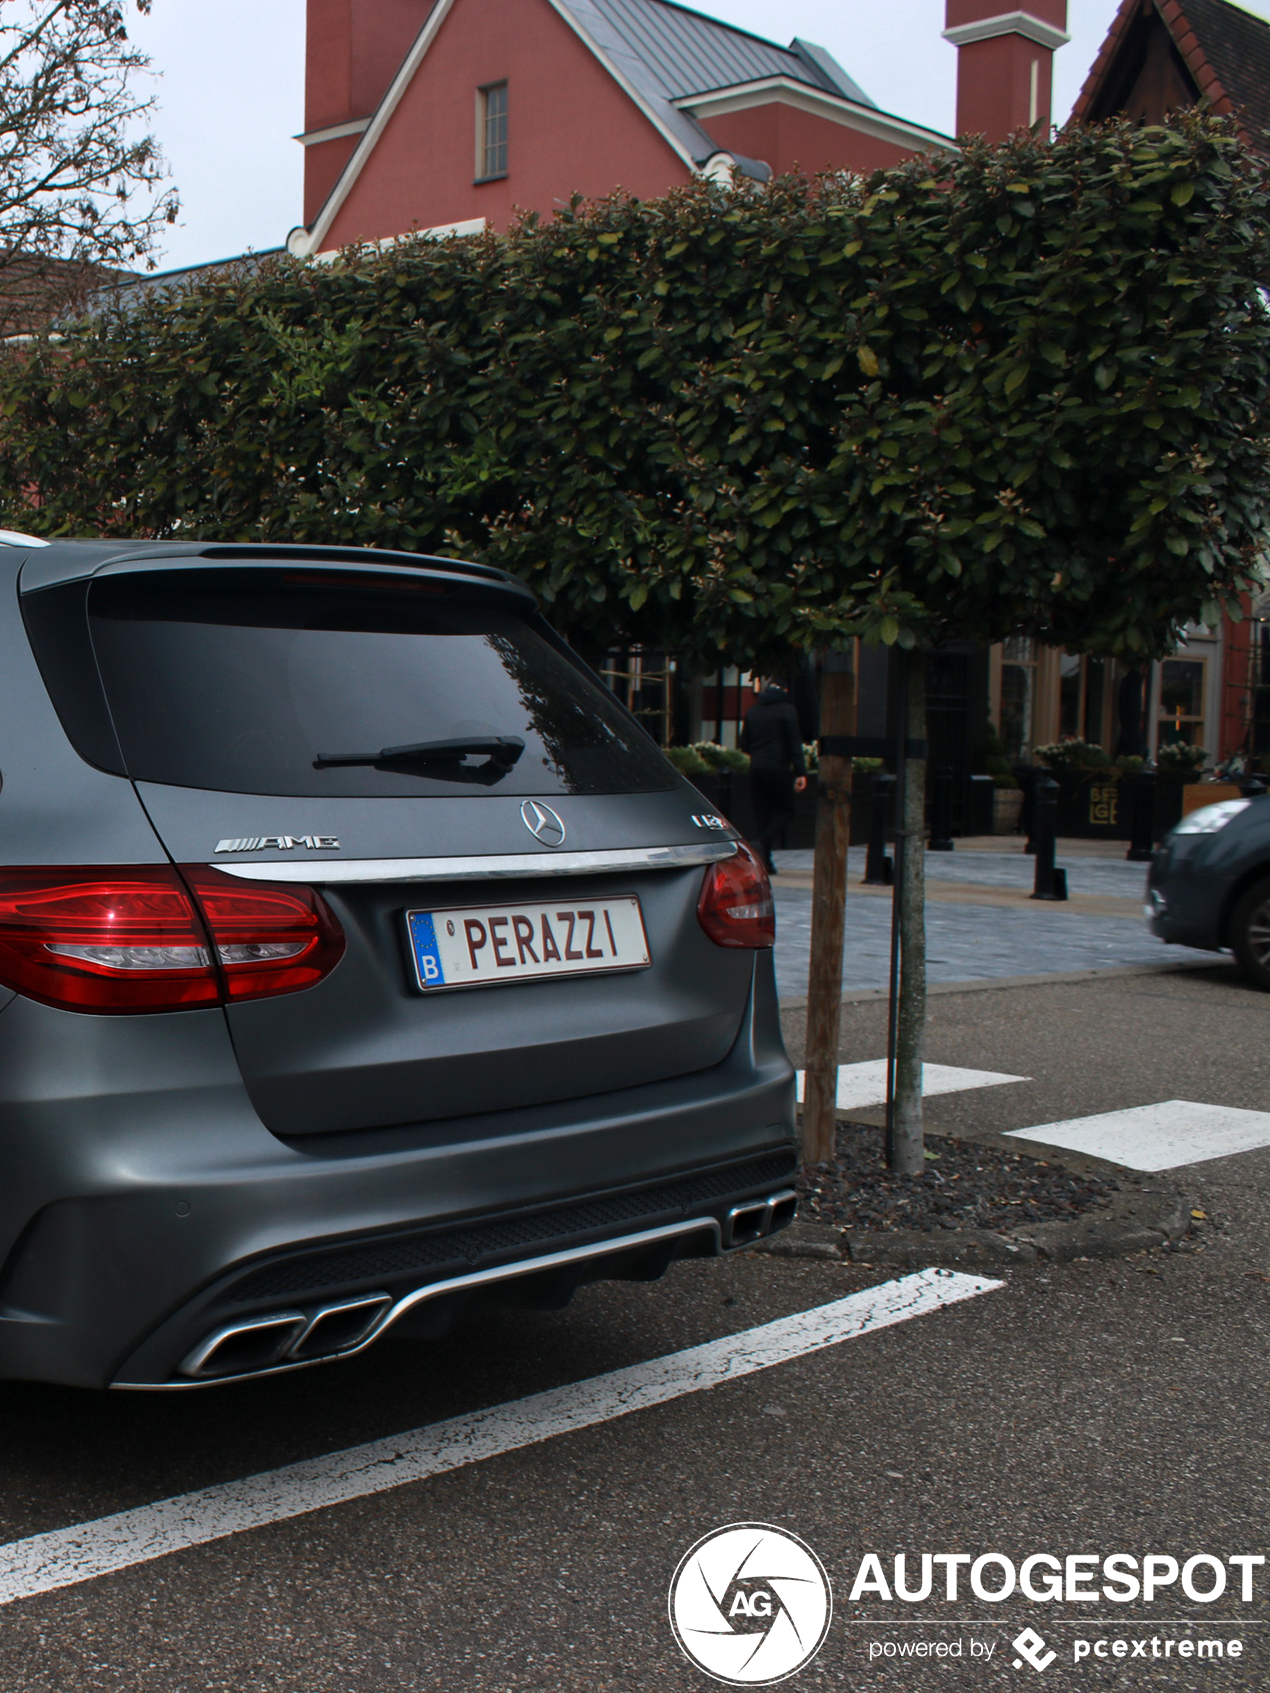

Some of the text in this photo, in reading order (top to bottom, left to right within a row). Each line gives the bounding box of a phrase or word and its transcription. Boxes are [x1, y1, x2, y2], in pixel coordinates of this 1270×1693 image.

[254, 835, 340, 851] AMG
[463, 909, 618, 970] PERAZZI
[421, 955, 440, 980] B
